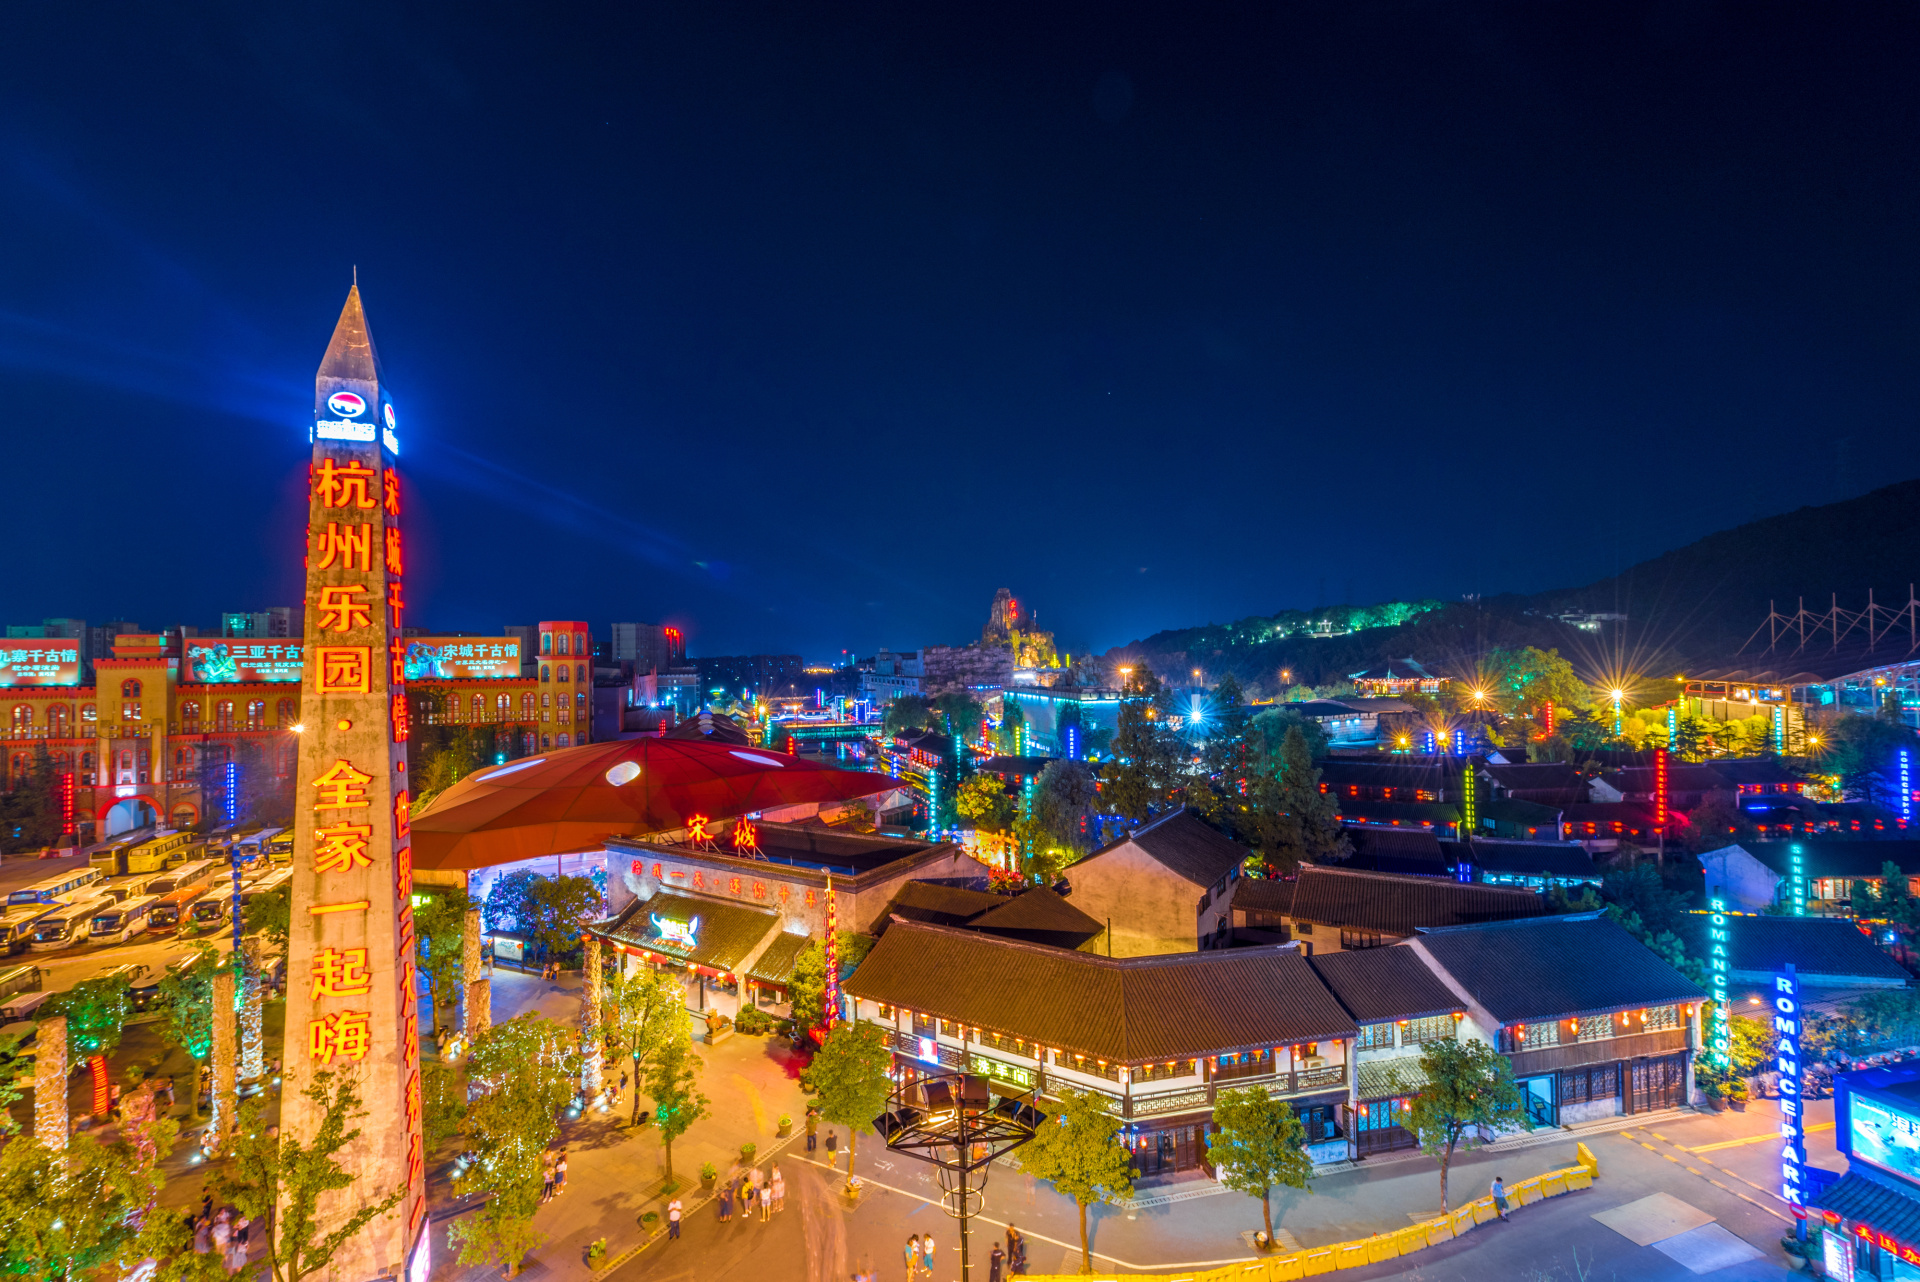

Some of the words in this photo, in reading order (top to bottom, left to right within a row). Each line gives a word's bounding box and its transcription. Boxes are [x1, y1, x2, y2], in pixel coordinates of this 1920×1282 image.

[231, 645, 304, 660] 三亚千古
[443, 643, 519, 658] 宋城千古情
[687, 813, 756, 847] 宋城
[828, 889, 838, 984] ROMANCE
[1711, 898, 1728, 1003] ROMANCE
[977, 1058, 1029, 1086] 洗手间
[1775, 976, 1798, 1118] ROMANCE
[1780, 1122, 1802, 1206] PARK
